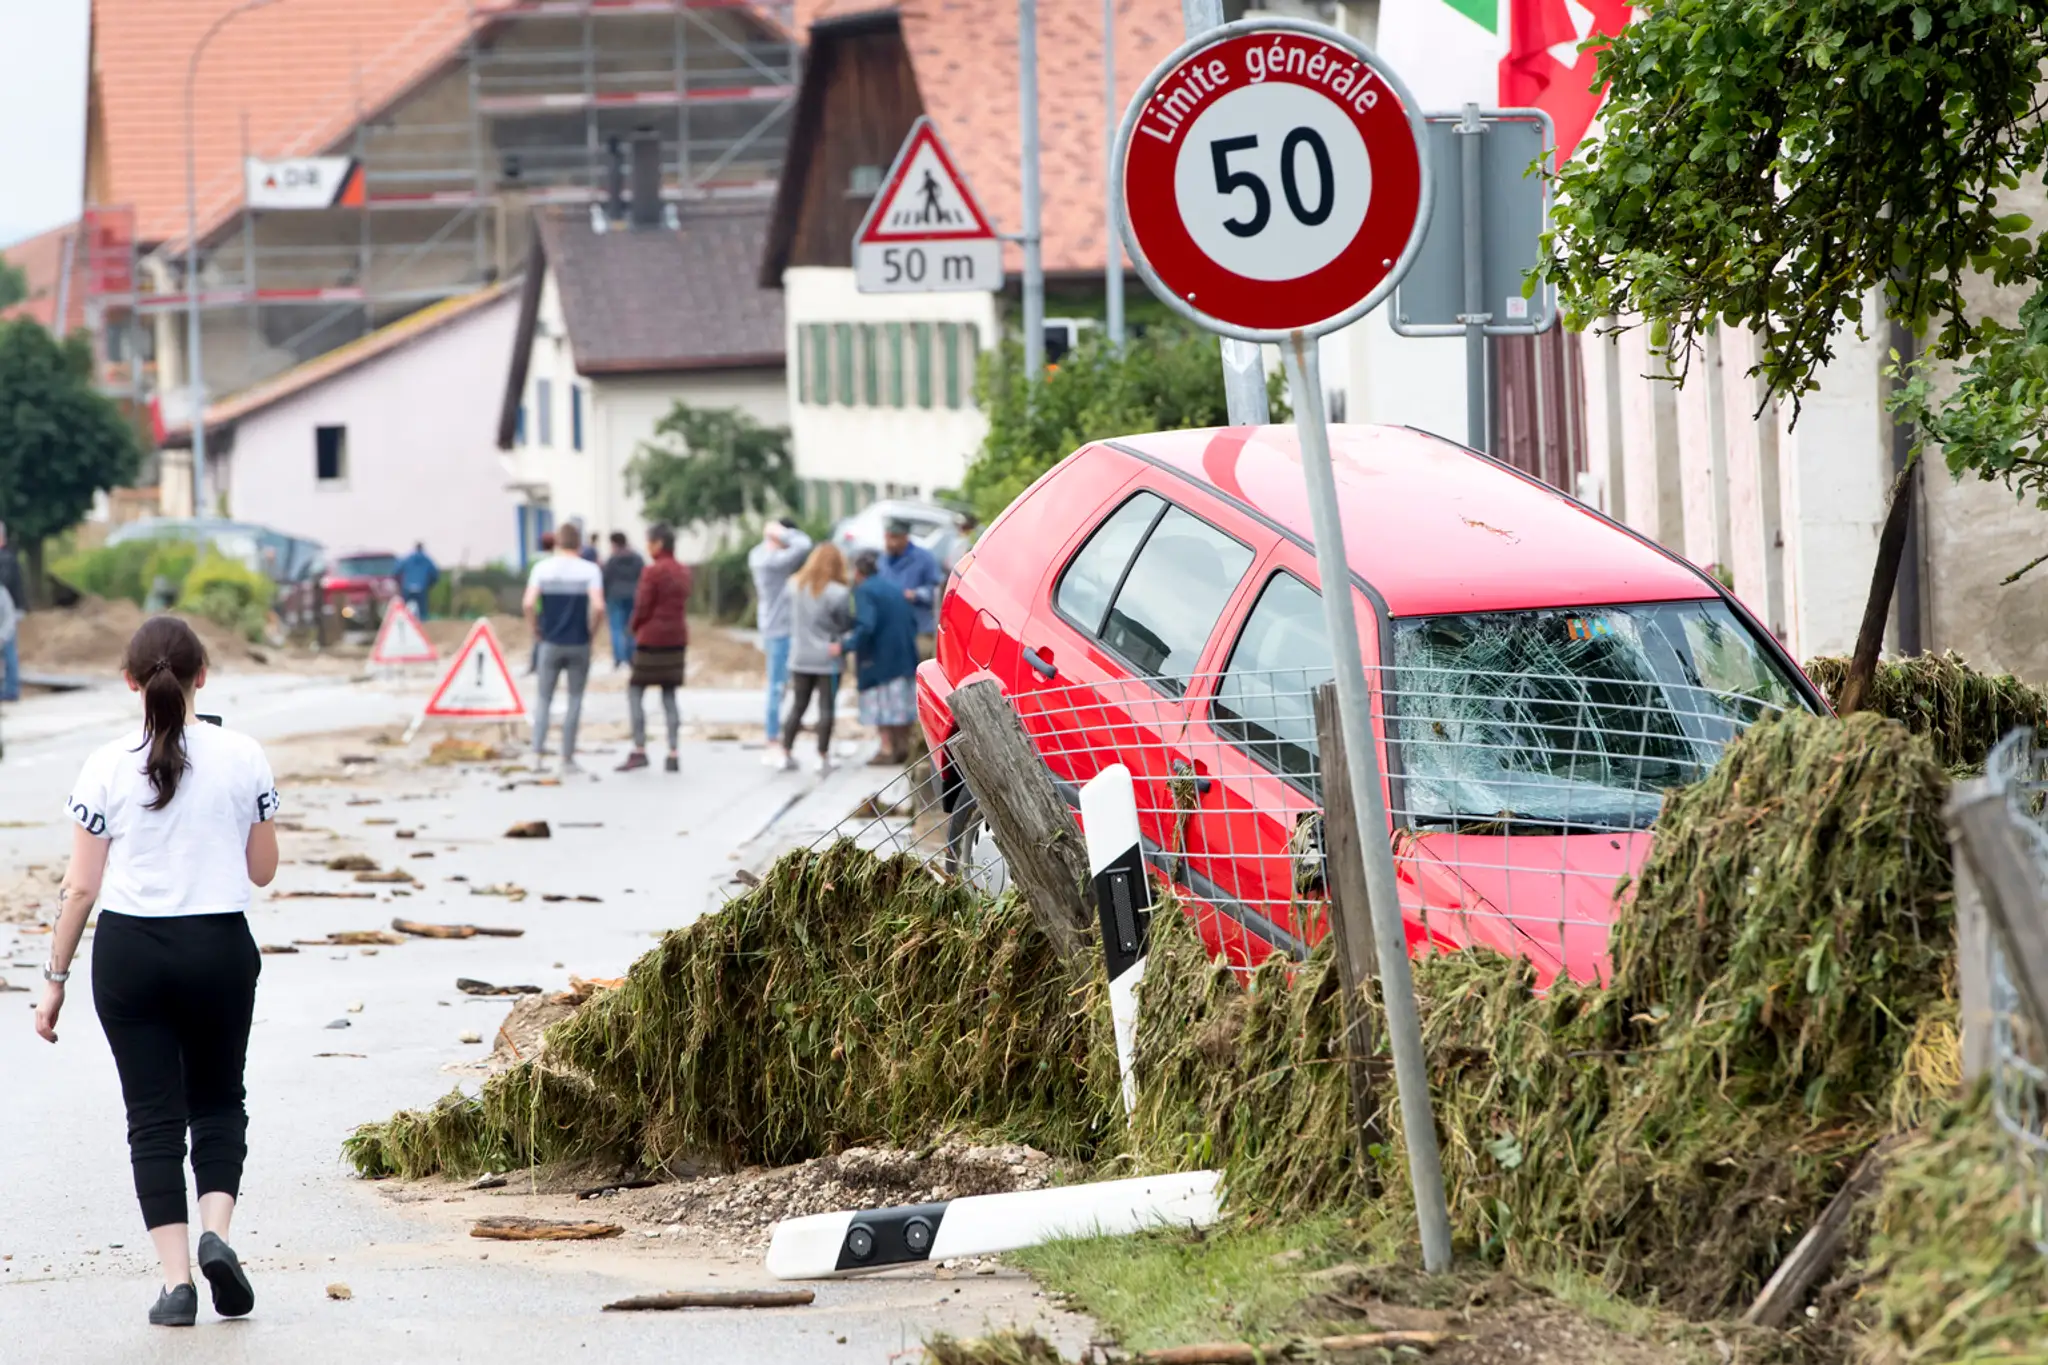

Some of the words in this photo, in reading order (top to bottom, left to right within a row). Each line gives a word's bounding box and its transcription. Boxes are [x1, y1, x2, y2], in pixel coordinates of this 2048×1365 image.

[1140, 58, 1230, 144] Limite
[1245, 36, 1378, 114] générale
[1210, 126, 1335, 238] 50
[883, 248, 926, 283] 50
[943, 255, 974, 280] m
[68, 795, 105, 835] OD
